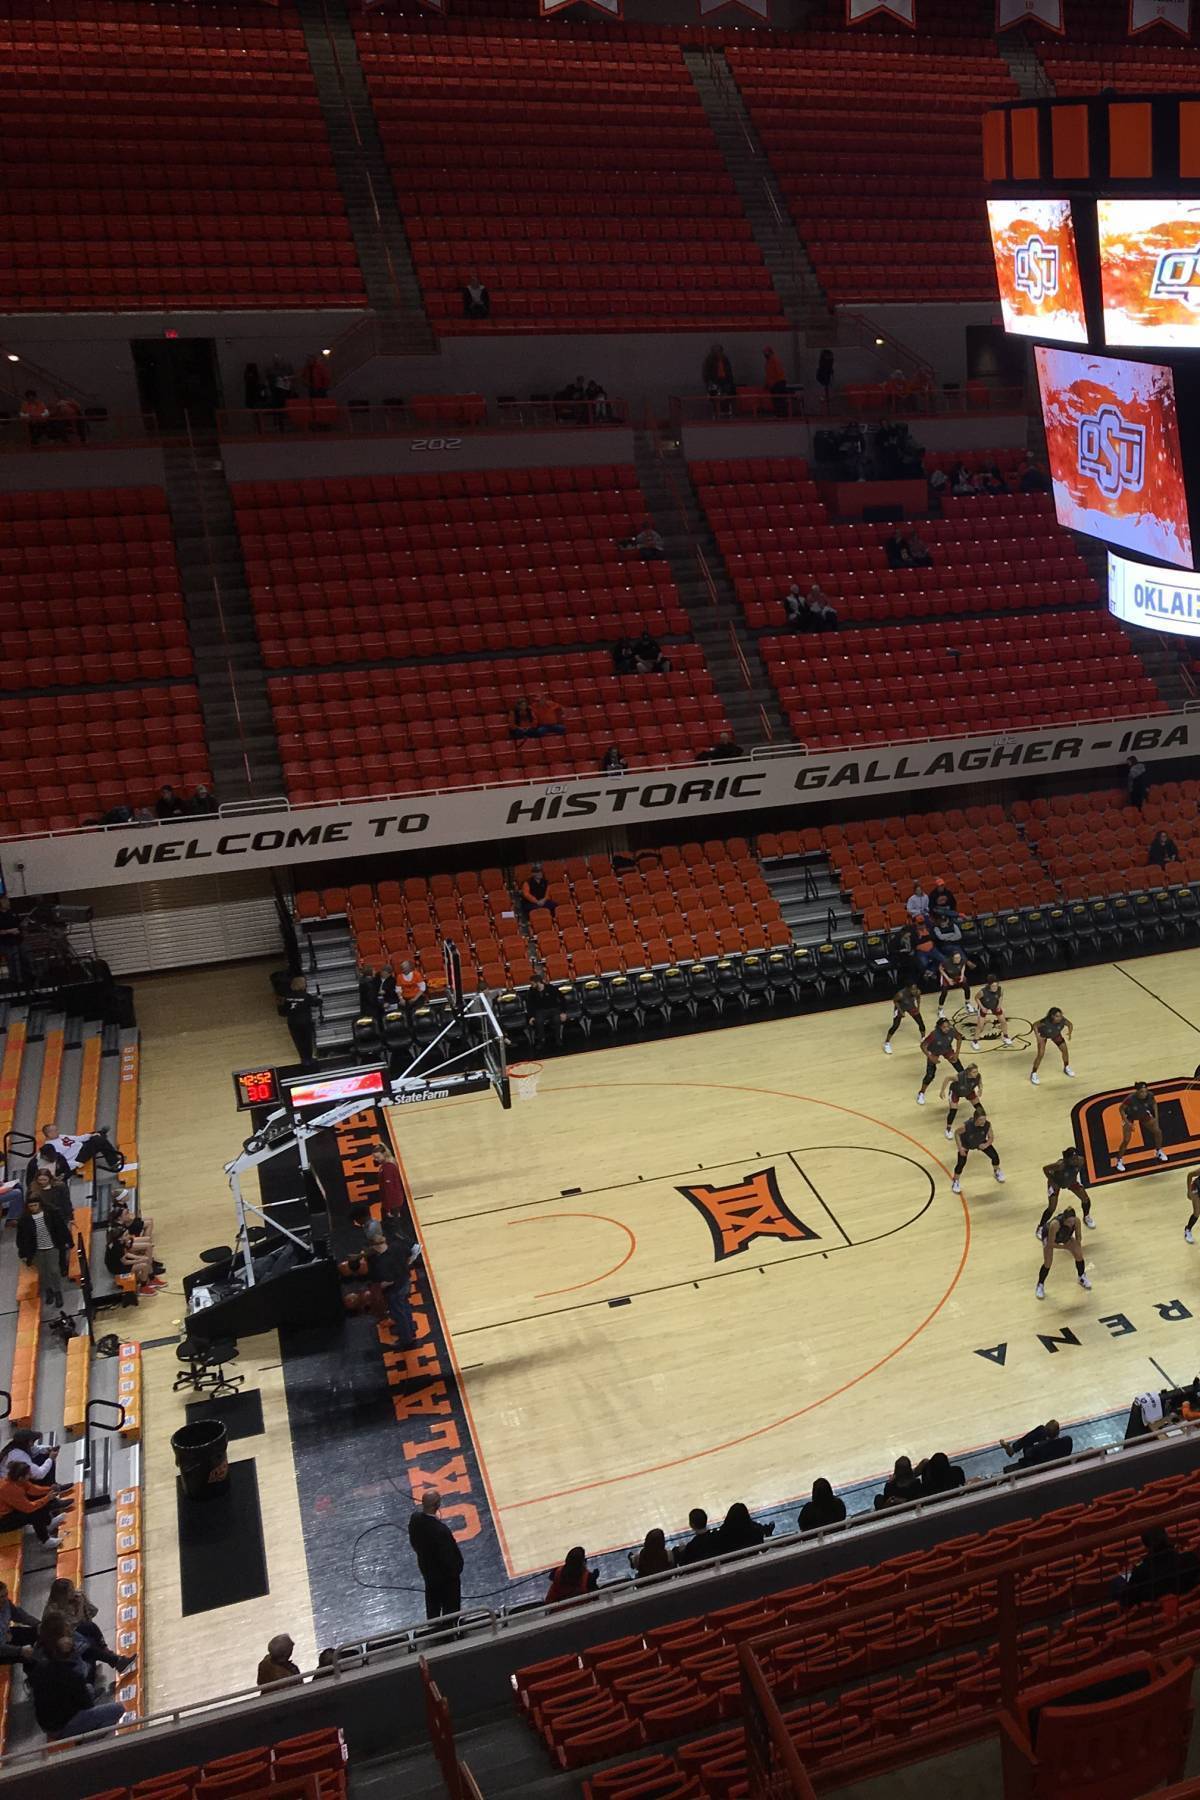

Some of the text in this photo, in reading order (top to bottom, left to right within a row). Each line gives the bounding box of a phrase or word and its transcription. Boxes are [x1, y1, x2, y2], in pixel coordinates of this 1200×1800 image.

[1016, 235, 1059, 304] OSU
[411, 437, 462, 451] 202
[1078, 403, 1146, 500] OSU
[114, 821, 352, 867] WELCOME
[368, 812, 430, 837] TO
[506, 772, 766, 824] HISTORIC
[239, 1071, 272, 1087] 42:52
[248, 1084, 270, 1101] 30
